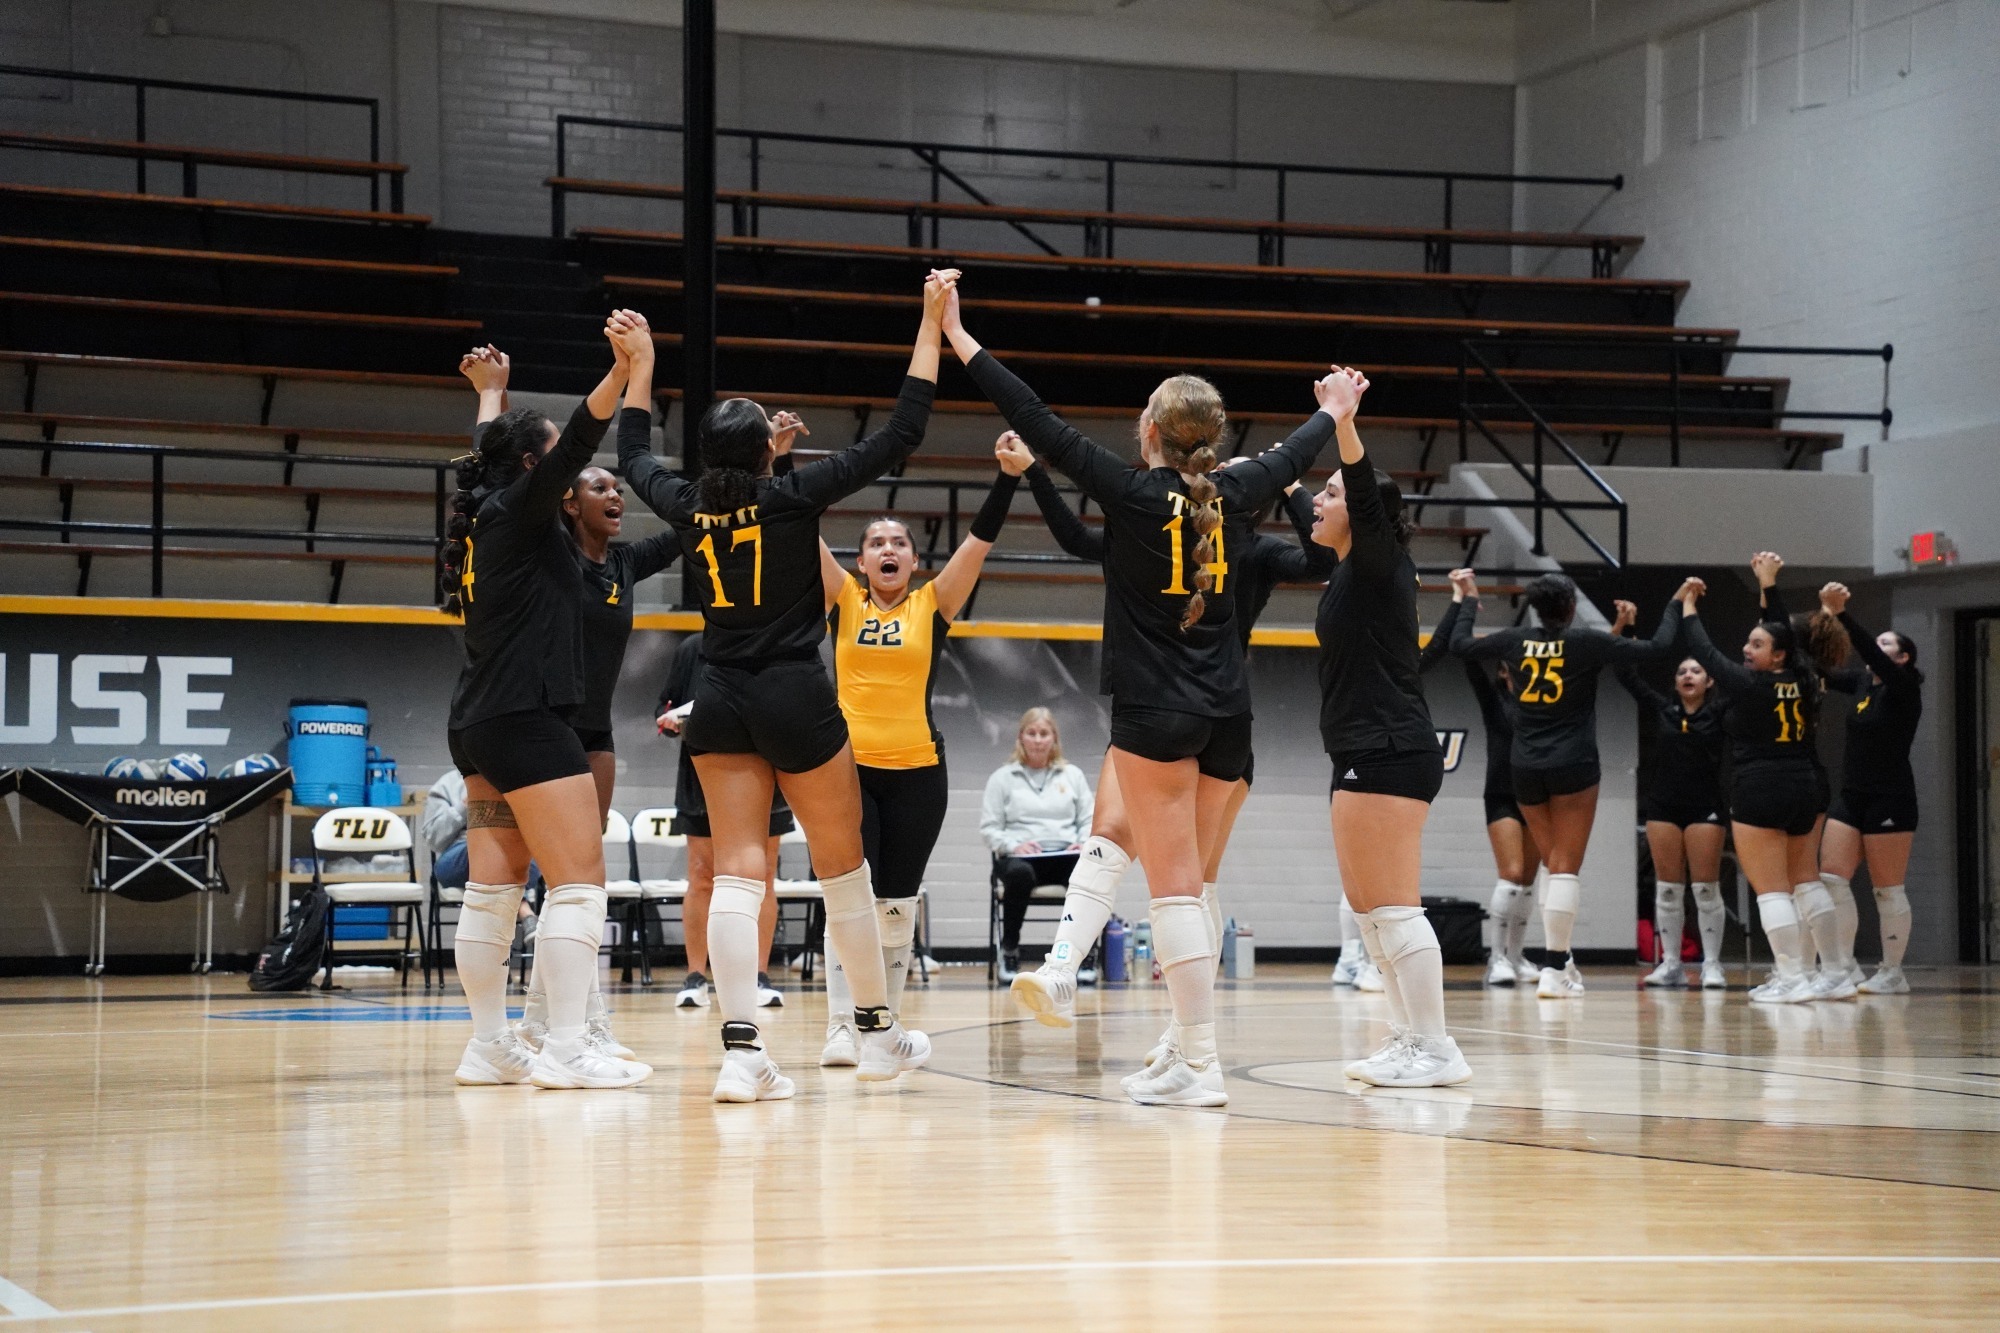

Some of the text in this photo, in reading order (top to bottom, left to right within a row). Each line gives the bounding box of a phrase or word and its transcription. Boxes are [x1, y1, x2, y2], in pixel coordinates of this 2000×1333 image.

[1168, 491, 1223, 516] TU
[695, 525, 761, 607] 17
[1161, 515, 1228, 594] 14
[857, 618, 902, 646] 22
[1519, 657, 1564, 704] 25
[0, 653, 233, 745] USE
[301, 722, 364, 736] POWERADE
[116, 786, 207, 807] molten
[333, 818, 390, 839] TLU
